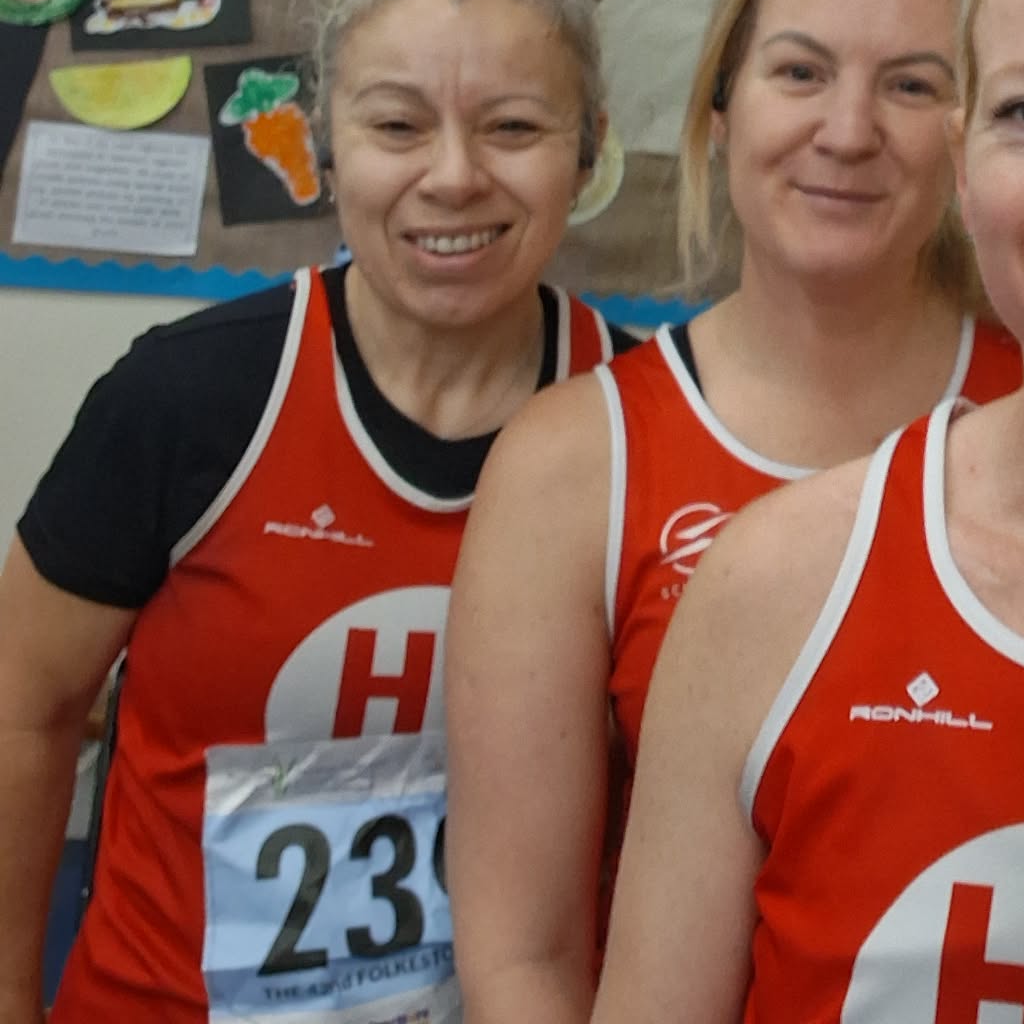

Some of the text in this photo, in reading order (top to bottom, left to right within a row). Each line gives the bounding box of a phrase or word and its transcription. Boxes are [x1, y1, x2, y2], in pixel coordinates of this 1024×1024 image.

[332, 627, 436, 739] H
[850, 705, 993, 731] RONHILL
[264, 985, 302, 1001] THE
